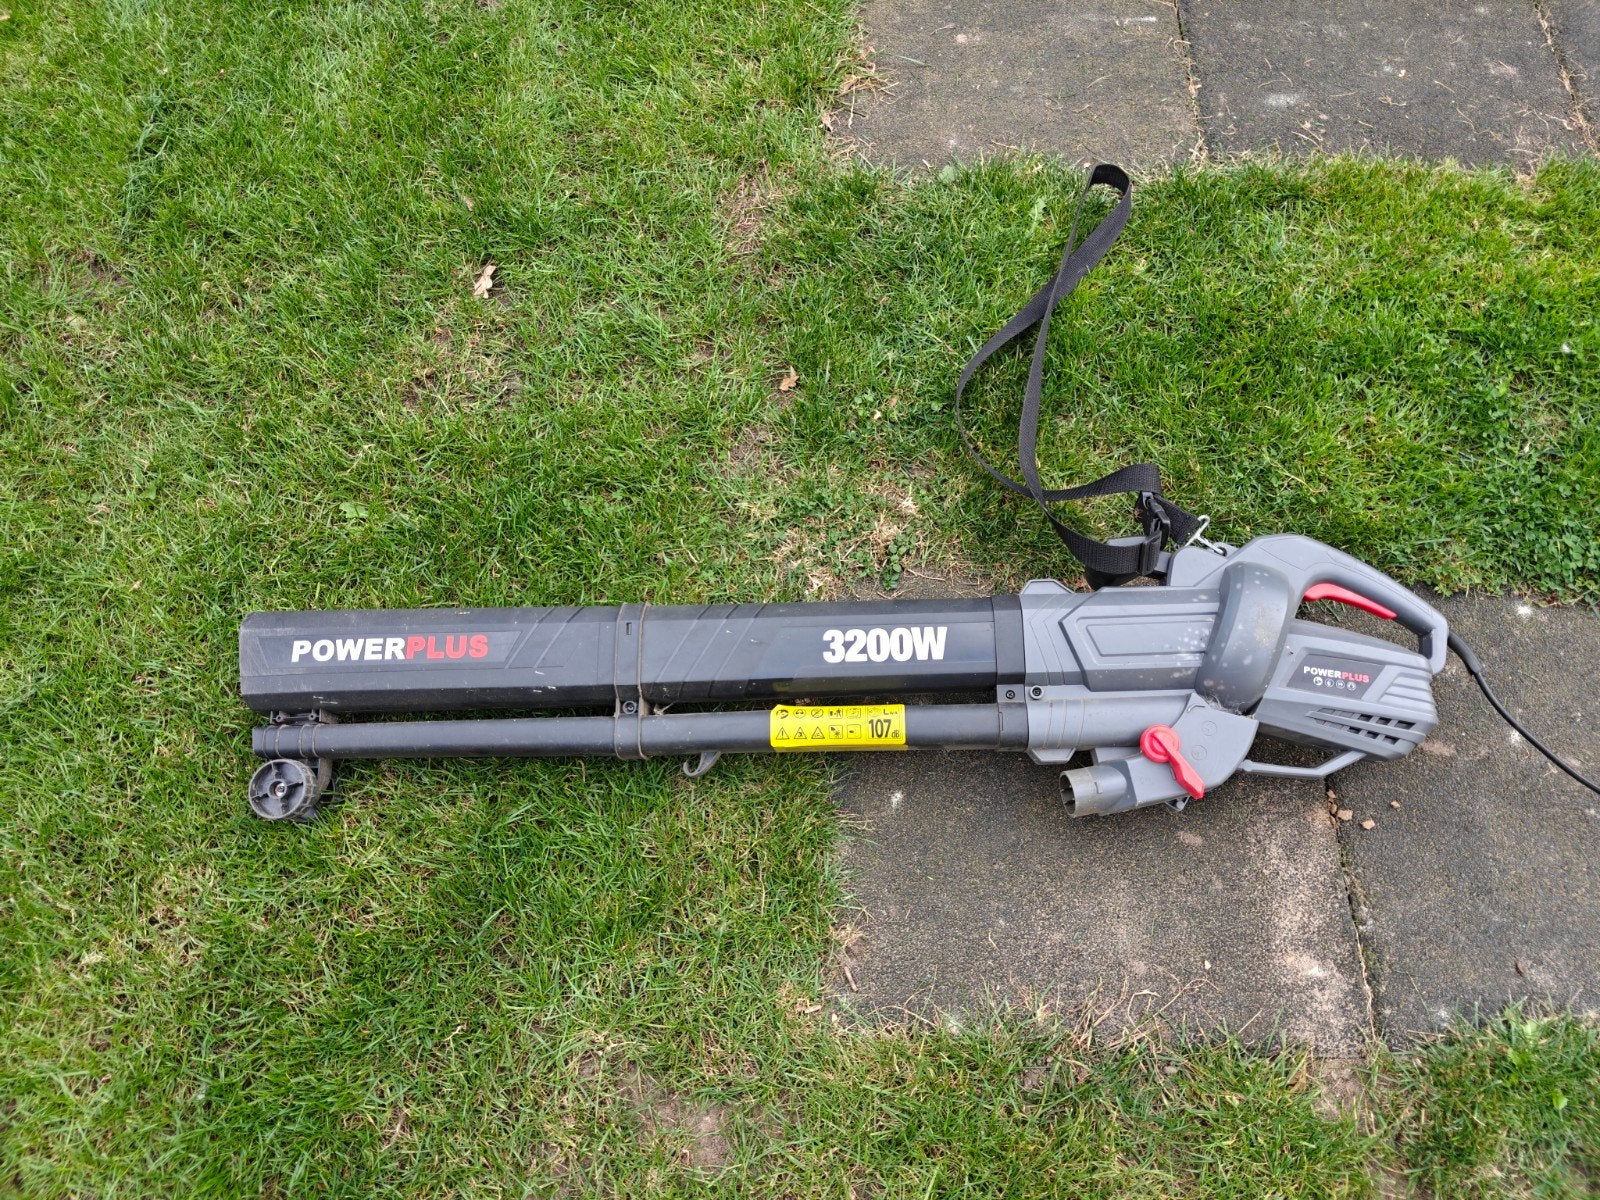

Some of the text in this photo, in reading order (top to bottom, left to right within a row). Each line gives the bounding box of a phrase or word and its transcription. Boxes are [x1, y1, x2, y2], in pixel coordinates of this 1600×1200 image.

[291, 634, 489, 663] POWERPLUS
[822, 626, 948, 663] 3200W
[1303, 666, 1370, 683] POWERPLUS
[868, 719, 891, 738] 107
